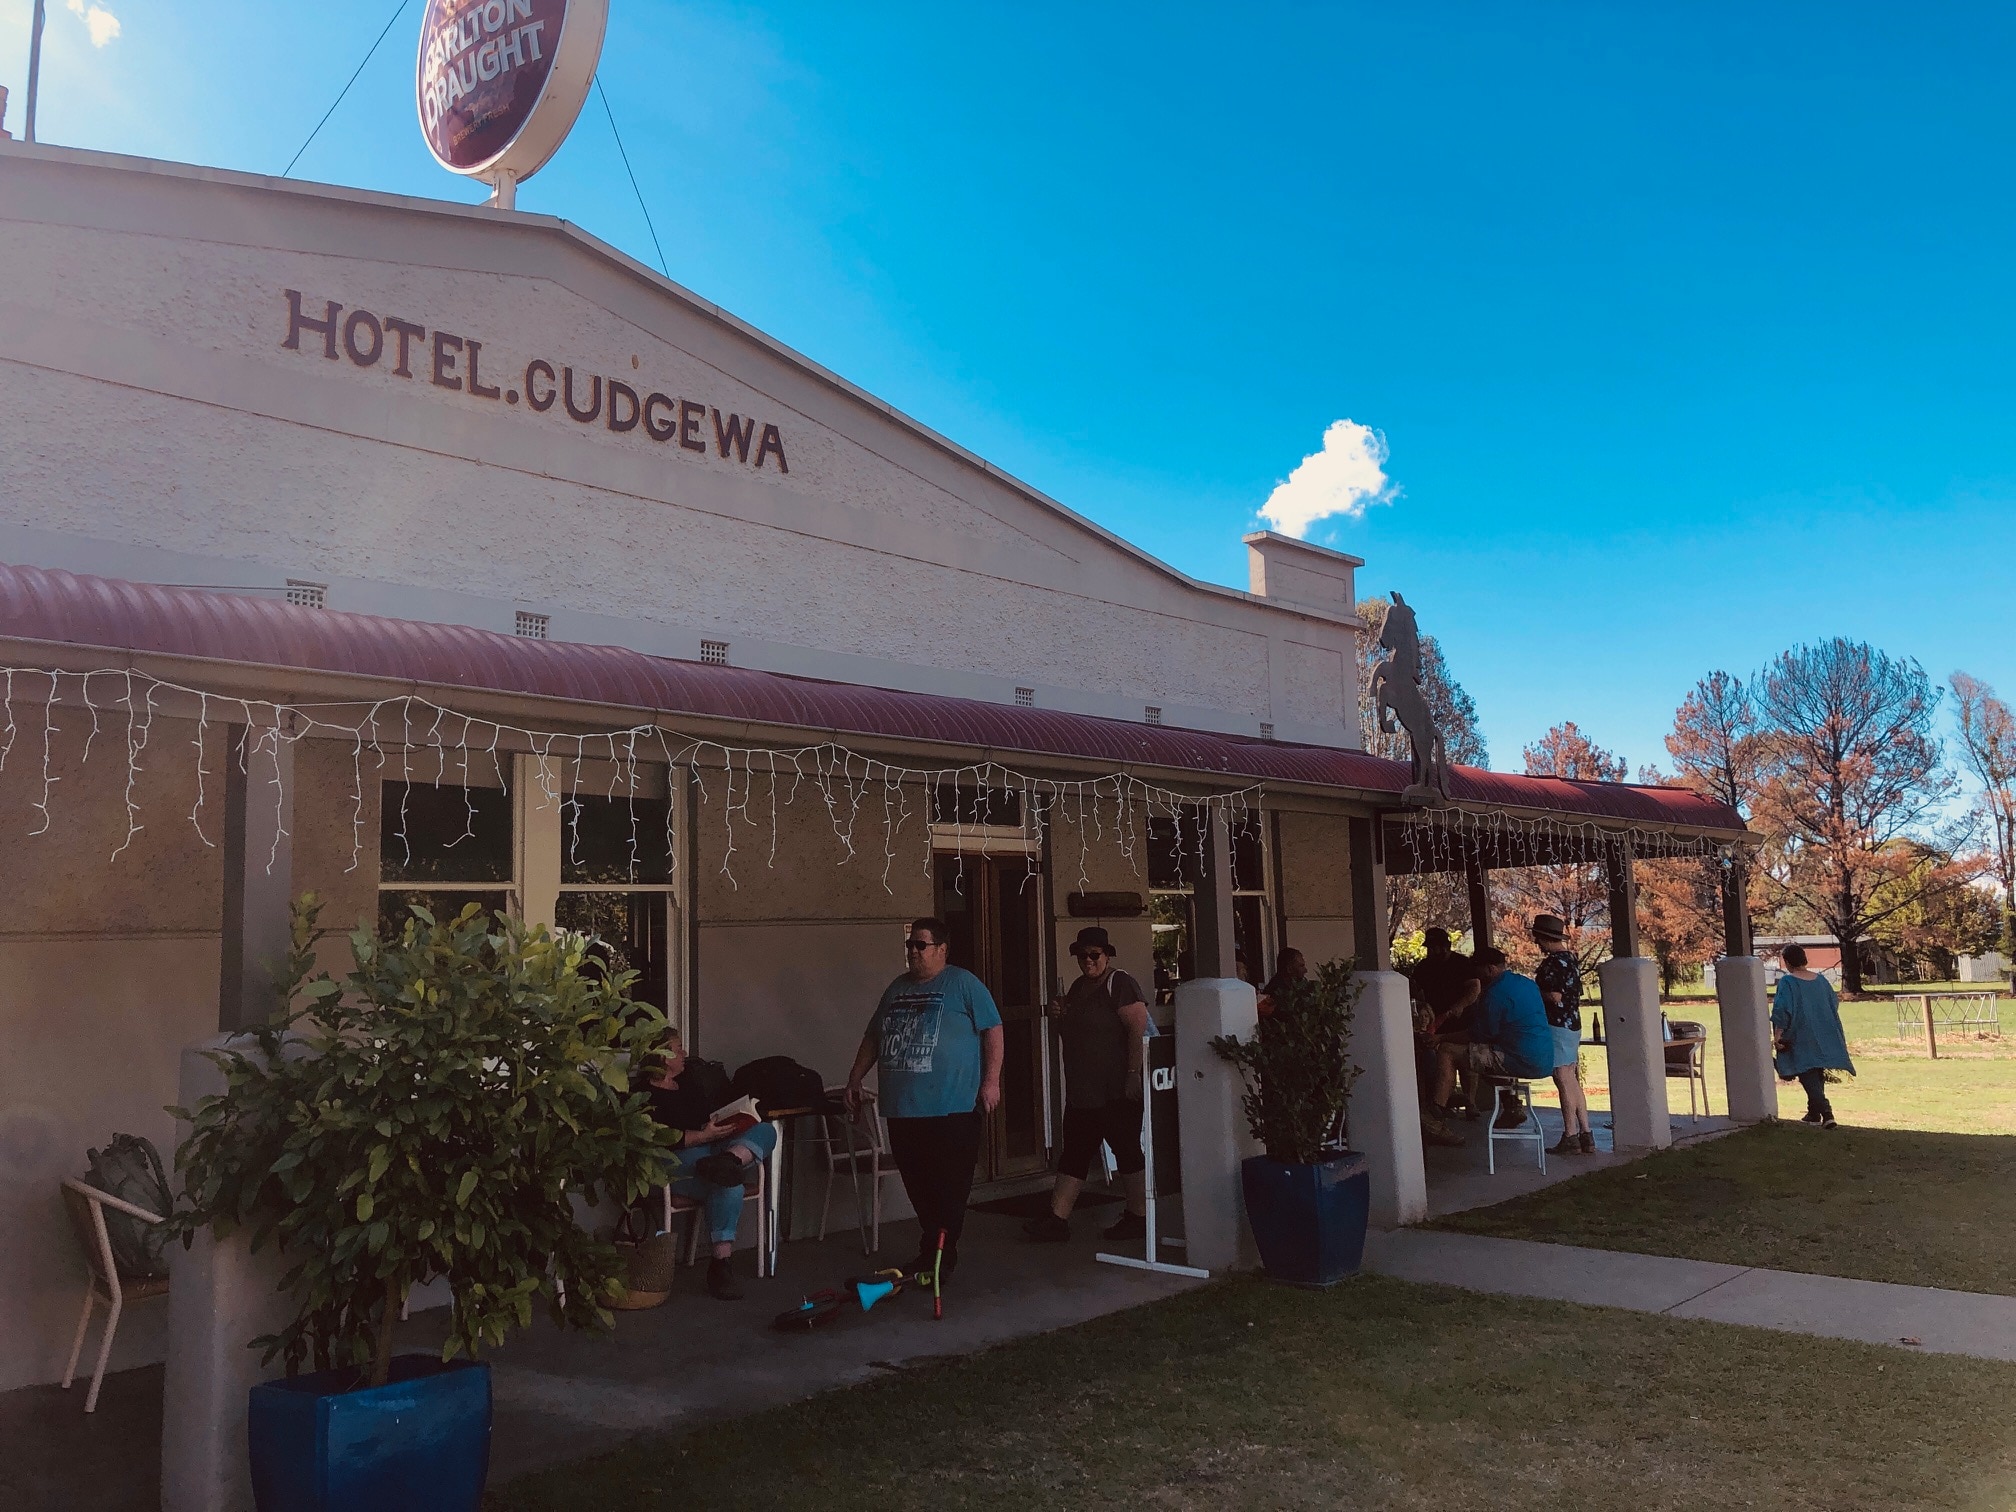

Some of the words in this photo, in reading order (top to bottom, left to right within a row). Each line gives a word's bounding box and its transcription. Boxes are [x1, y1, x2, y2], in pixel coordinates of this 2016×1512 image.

[424, 20, 545, 133] DRAUGHT
[452, 119, 483, 146] BREWERY
[482, 103, 511, 123] FRESH
[911, 1045, 931, 1055] 1989
